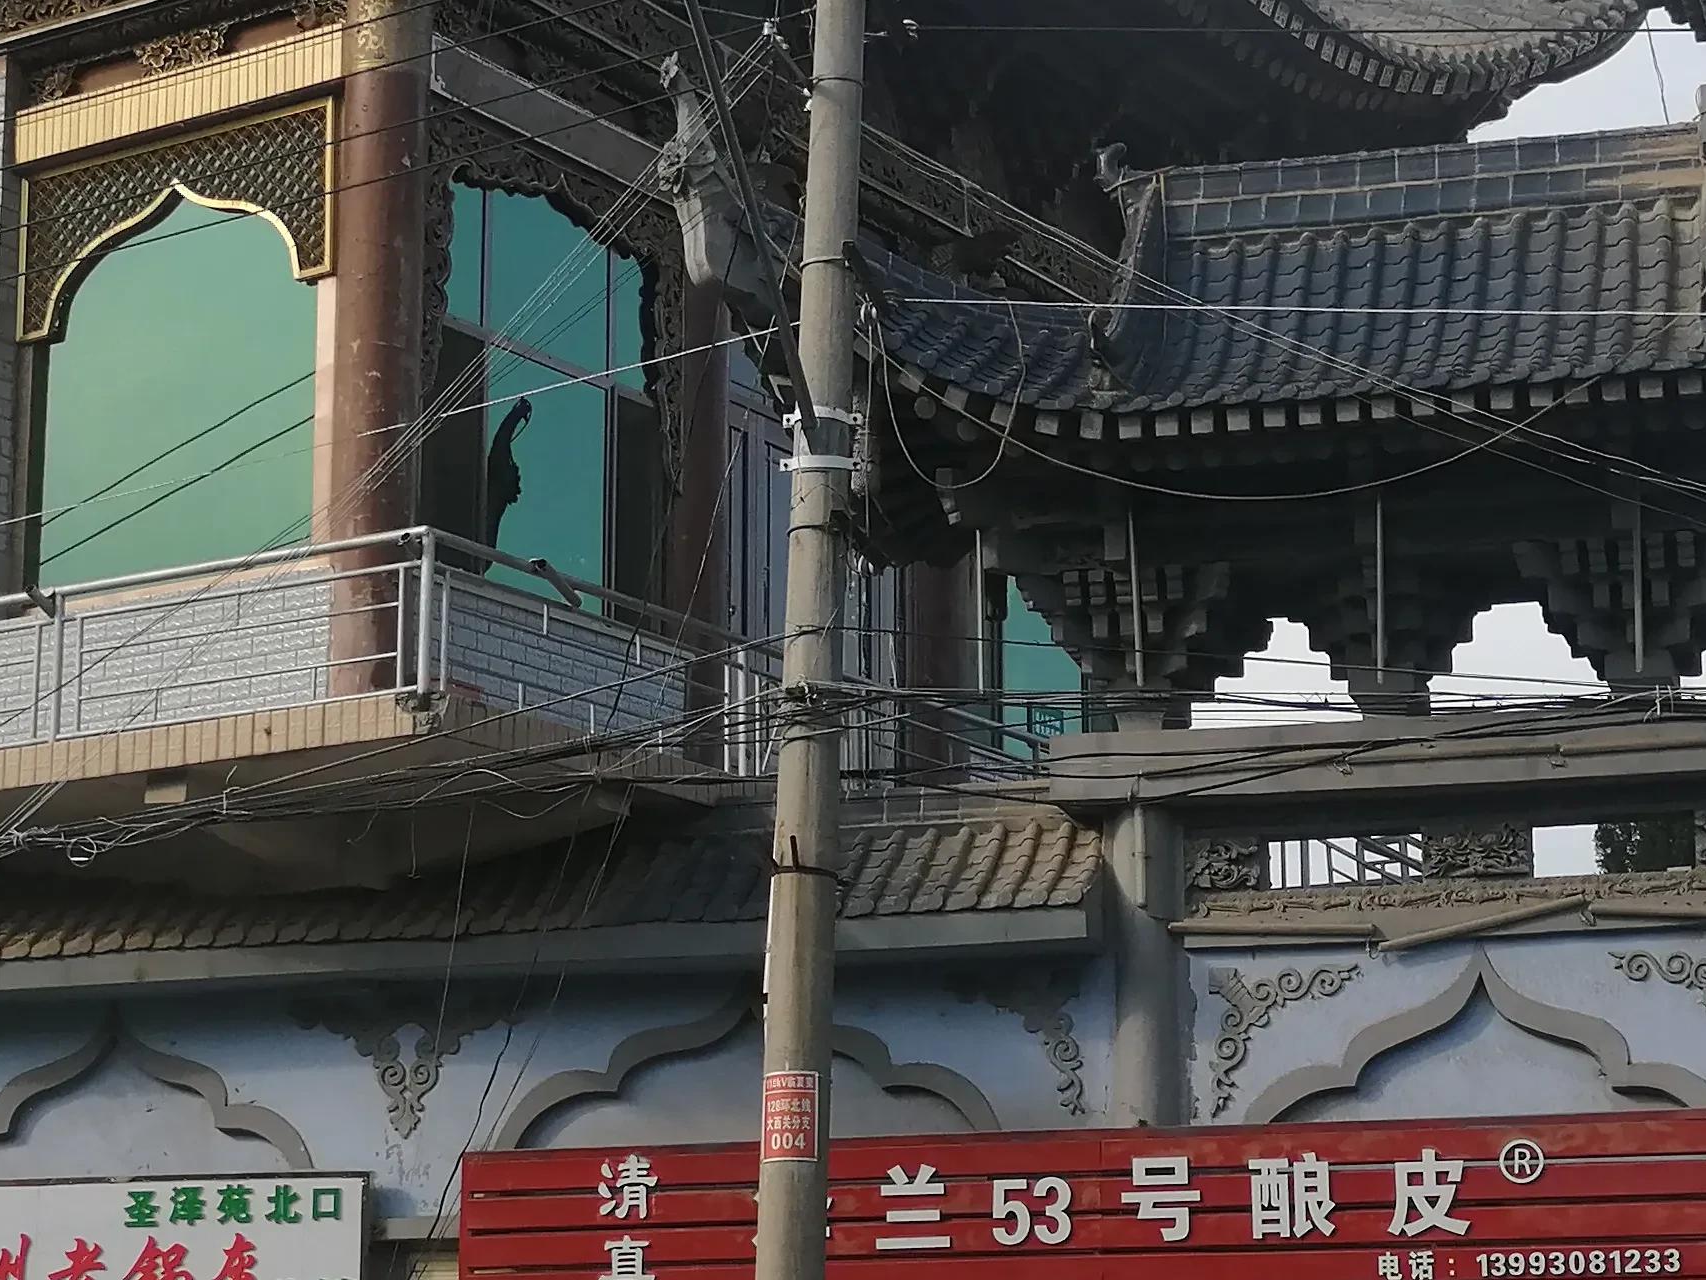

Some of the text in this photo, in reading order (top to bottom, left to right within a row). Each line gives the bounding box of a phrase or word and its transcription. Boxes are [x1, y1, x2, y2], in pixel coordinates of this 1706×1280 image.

[771, 1132, 806, 1150] 004
[124, 1183, 342, 1228] 圣泽苑北口
[1476, 1248, 1681, 1277] 13993081233
